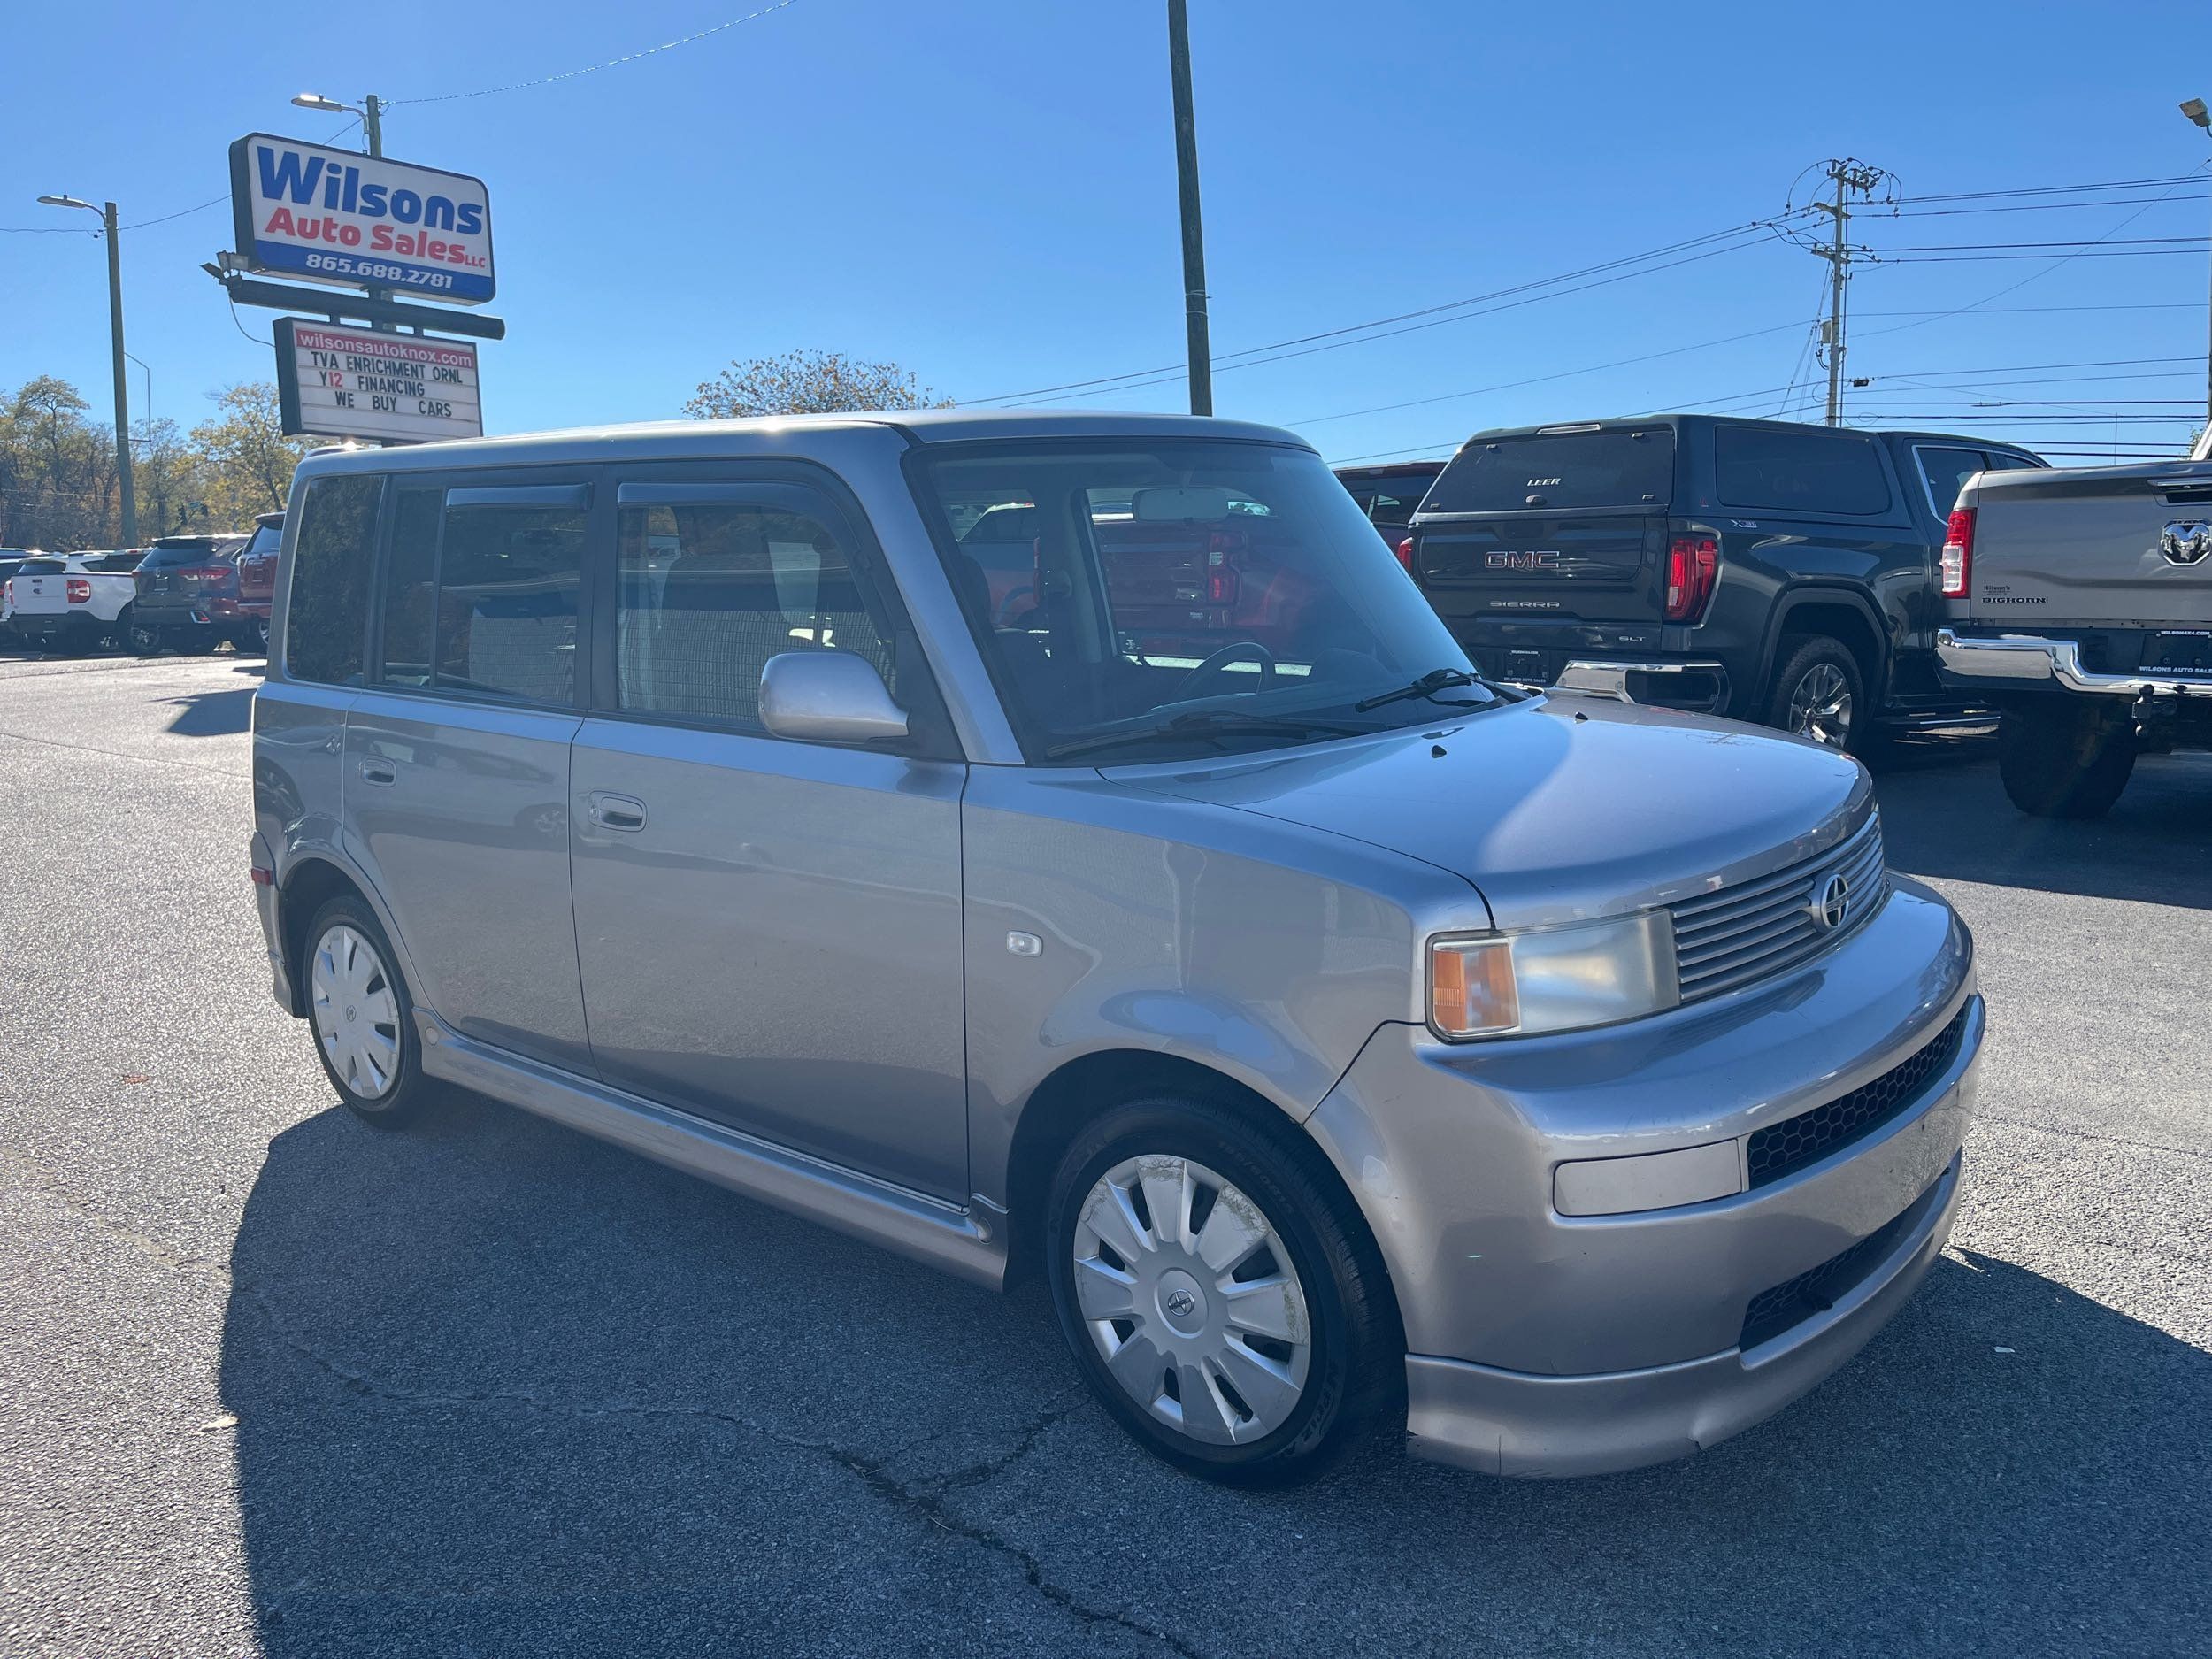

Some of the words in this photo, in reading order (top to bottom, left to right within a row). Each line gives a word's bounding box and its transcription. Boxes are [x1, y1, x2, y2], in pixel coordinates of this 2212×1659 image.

[257, 146, 483, 234] Wilsons
[265, 207, 361, 246] Auto
[370, 224, 465, 264] Sales
[465, 254, 486, 268] LLC
[306, 253, 452, 288] 865.688.2781
[300, 333, 472, 367] wilsonsautoknox.com
[311, 351, 339, 369] TVA
[347, 356, 425, 379] ENRICHMENT
[433, 366, 463, 383] ORNL
[319, 371, 343, 388] Y12
[357, 375, 425, 396] FINANCING
[335, 391, 354, 408] WE
[373, 396, 396, 411] BUY
[419, 400, 452, 417] CARS
[1527, 478, 1562, 487] LEER
[1485, 551, 1560, 568] GMC
